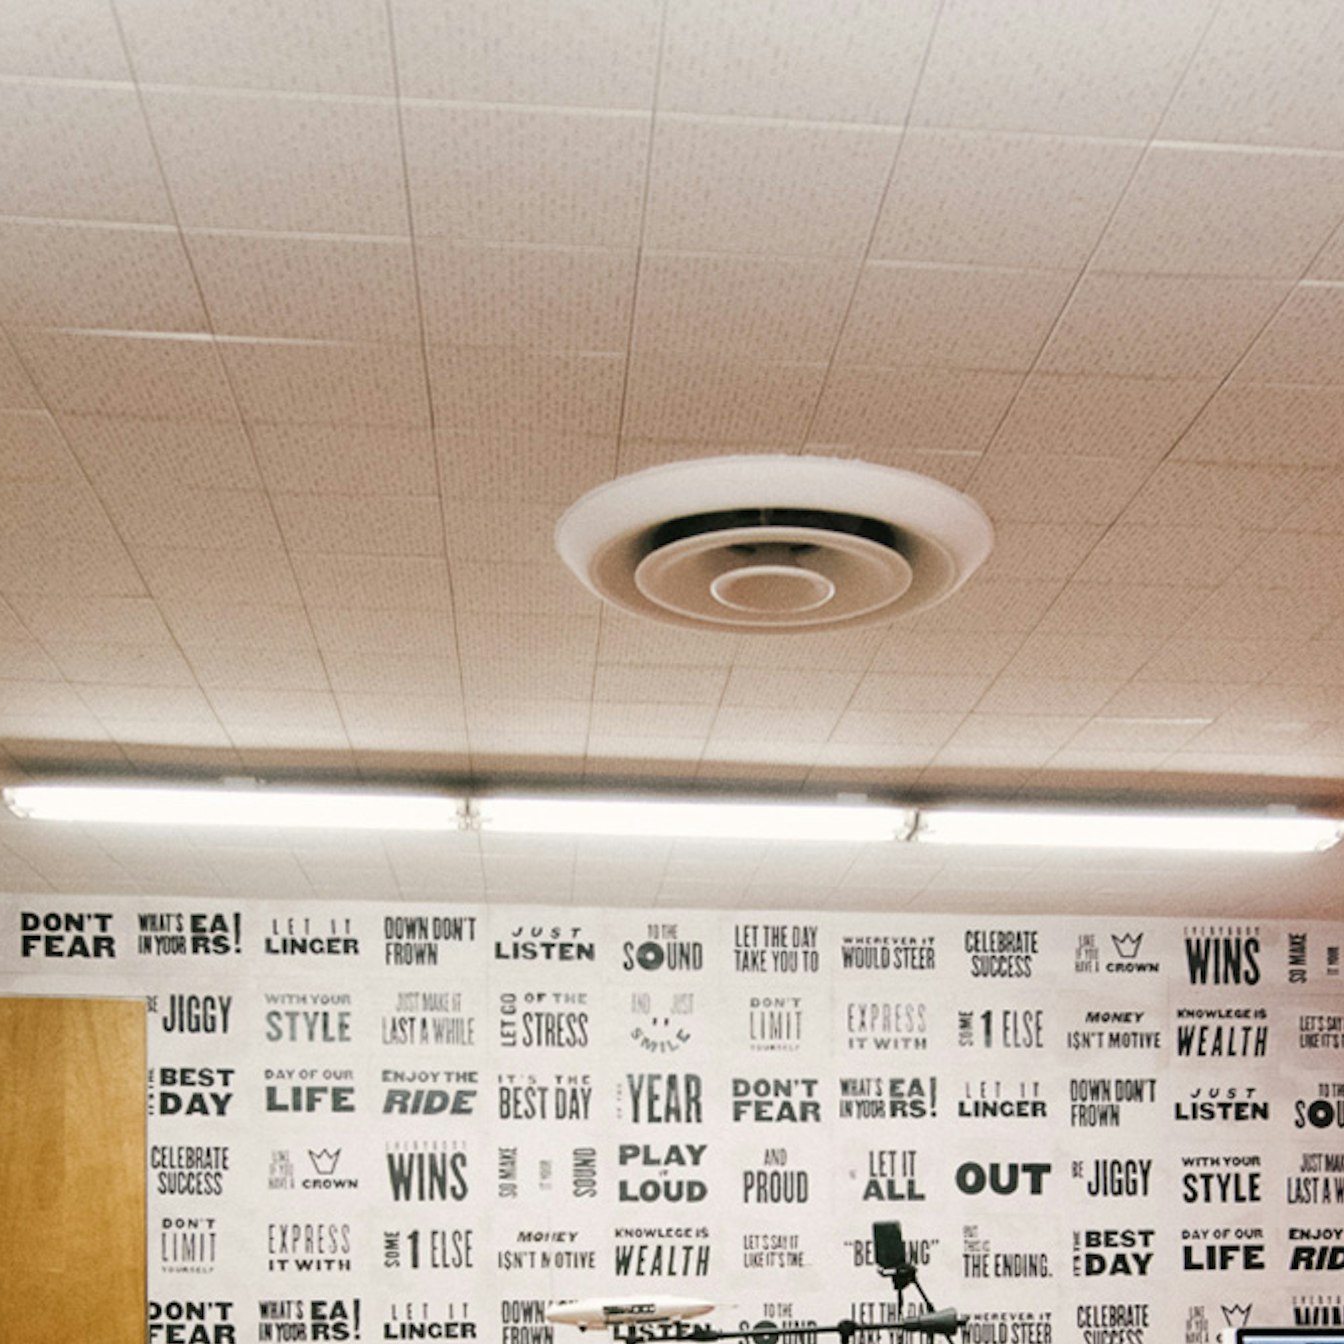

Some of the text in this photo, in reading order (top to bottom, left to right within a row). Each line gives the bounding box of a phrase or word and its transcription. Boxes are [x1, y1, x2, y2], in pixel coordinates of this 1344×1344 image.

[20, 911, 113, 933] DON'T
[271, 917, 351, 936] LET IT
[384, 916, 477, 942] DOWN DON'T
[511, 926, 582, 940] JUST
[21, 934, 116, 959] FEAR
[264, 937, 360, 956] LINGER
[734, 924, 818, 949] LET THE DAY
[964, 929, 1039, 954] CELEBRATE
[385, 941, 438, 966] FROWN
[494, 941, 595, 961] LISTEN
[733, 948, 820, 974] TAKE YOU TO
[841, 945, 936, 971] WOULD STEER
[1185, 936, 1261, 986] WINS
[971, 954, 1033, 979] SUCCESS
[1105, 962, 1160, 973] CROWN
[523, 992, 588, 1005] OF THE
[749, 996, 801, 1009] DON'T
[162, 994, 232, 1034] JIGGY
[265, 1009, 351, 1043] STYLE
[749, 1010, 803, 1041] LIMIT
[847, 1002, 927, 1034] EXPRESS
[1085, 1011, 1145, 1024] MONEY
[522, 1011, 589, 1048] STRESS
[1002, 1009, 1044, 1049] ELSE
[1108, 1031, 1161, 1049] MOTIVE
[1177, 1025, 1269, 1057] WEALTH
[848, 1037, 928, 1050] IT WITH
[159, 1067, 235, 1088] BEST
[263, 1068, 354, 1081] DAY OF OUR
[381, 1068, 479, 1084] ENJOY THE
[265, 1085, 356, 1113] LIFE
[626, 1073, 703, 1124] YEAR
[732, 1078, 819, 1099] DON'T
[159, 1091, 233, 1117] DAY
[382, 1088, 478, 1116] RIDE
[733, 1099, 821, 1123] FEAR
[958, 1100, 1048, 1118] LINGER
[1174, 1101, 1270, 1122] LISTEN
[150, 1145, 229, 1171] CELEBRATE
[618, 1144, 708, 1167] PLAY
[157, 1170, 223, 1196] SUCCESS
[301, 1178, 359, 1190] CROWN
[386, 1151, 469, 1202] WINS
[743, 1169, 809, 1204] PROUD
[955, 1161, 1052, 1196] OUT
[1087, 1159, 1153, 1197] JIGGY
[1182, 1172, 1262, 1204] STYLE
[618, 1179, 708, 1203] LOUD
[862, 1178, 926, 1202] ALL
[1084, 1229, 1156, 1248] BEST
[1084, 1252, 1154, 1277] DAY
[1183, 1244, 1266, 1271] LIFE
